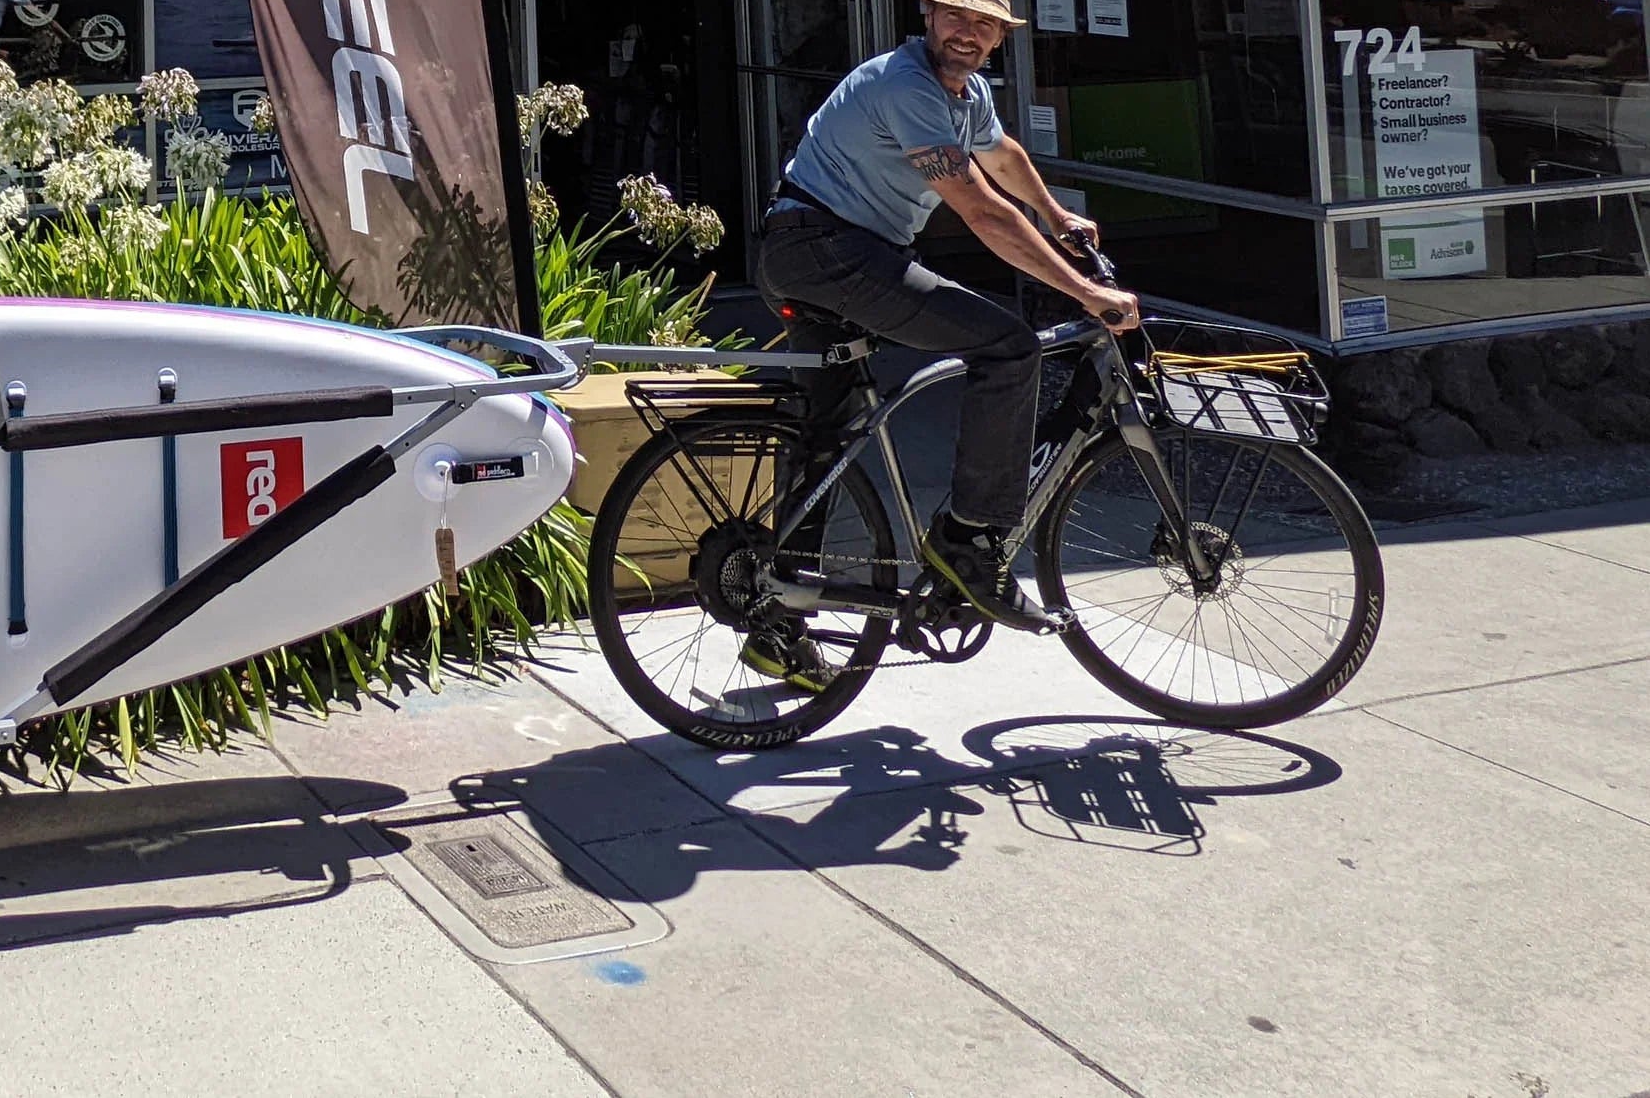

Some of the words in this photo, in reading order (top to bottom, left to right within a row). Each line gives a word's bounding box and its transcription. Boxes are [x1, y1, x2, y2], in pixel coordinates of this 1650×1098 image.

[1334, 25, 1426, 76] 724
[1378, 75, 1449, 91] Freelancer?
[1379, 94, 1451, 110] Contractor?
[1380, 114, 1417, 129] Small
[1418, 111, 1467, 127] business
[1381, 128, 1429, 144] owner?
[1082, 146, 1148, 161] welcome
[1384, 165, 1424, 179] We've
[1426, 165, 1446, 180] got
[1447, 162, 1471, 178] your
[1384, 183, 1422, 196] taxes
[1423, 178, 1471, 194] covered.
